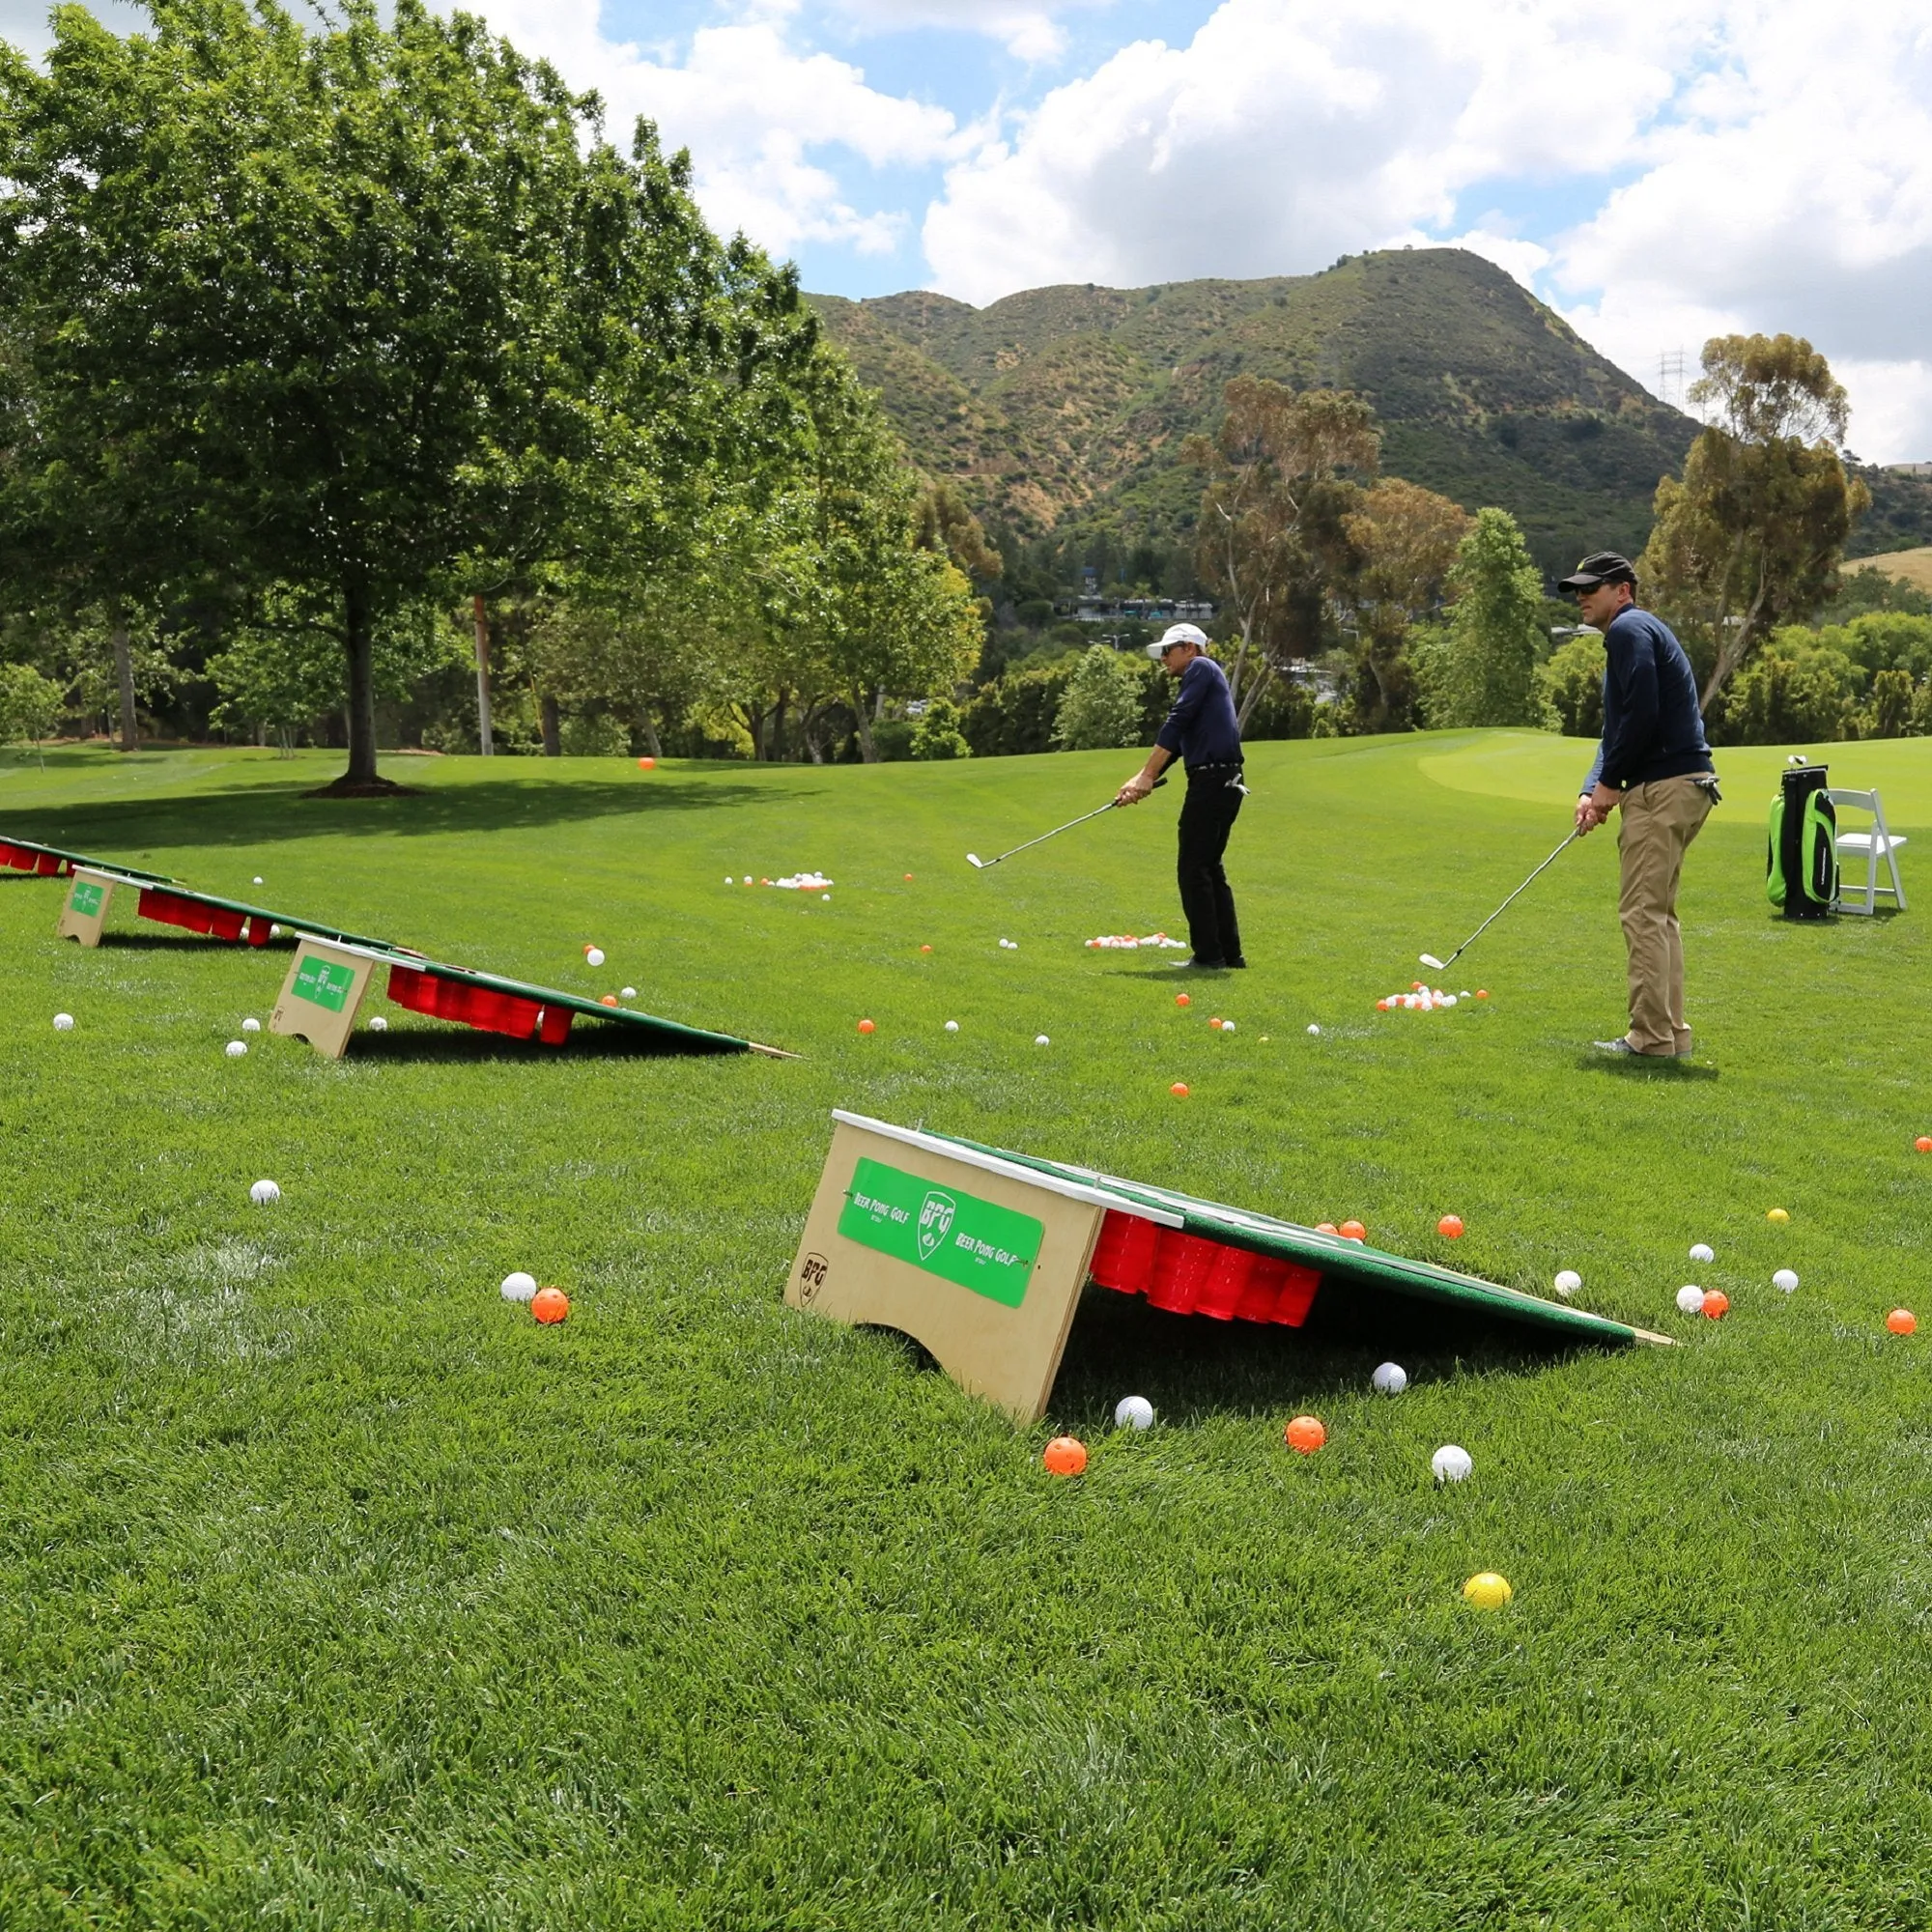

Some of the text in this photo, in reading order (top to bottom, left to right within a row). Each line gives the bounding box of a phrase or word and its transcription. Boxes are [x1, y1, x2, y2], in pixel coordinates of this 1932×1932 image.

[854, 1192, 870, 1208] BEER
[869, 1199, 890, 1216] PONG
[891, 1207, 910, 1224] GOLF
[920, 1201, 954, 1234] BPG
[955, 1233, 975, 1251] BEER
[974, 1239, 995, 1259] PONG
[995, 1248, 1017, 1266] GOLF
[802, 1259, 827, 1286] BPG
